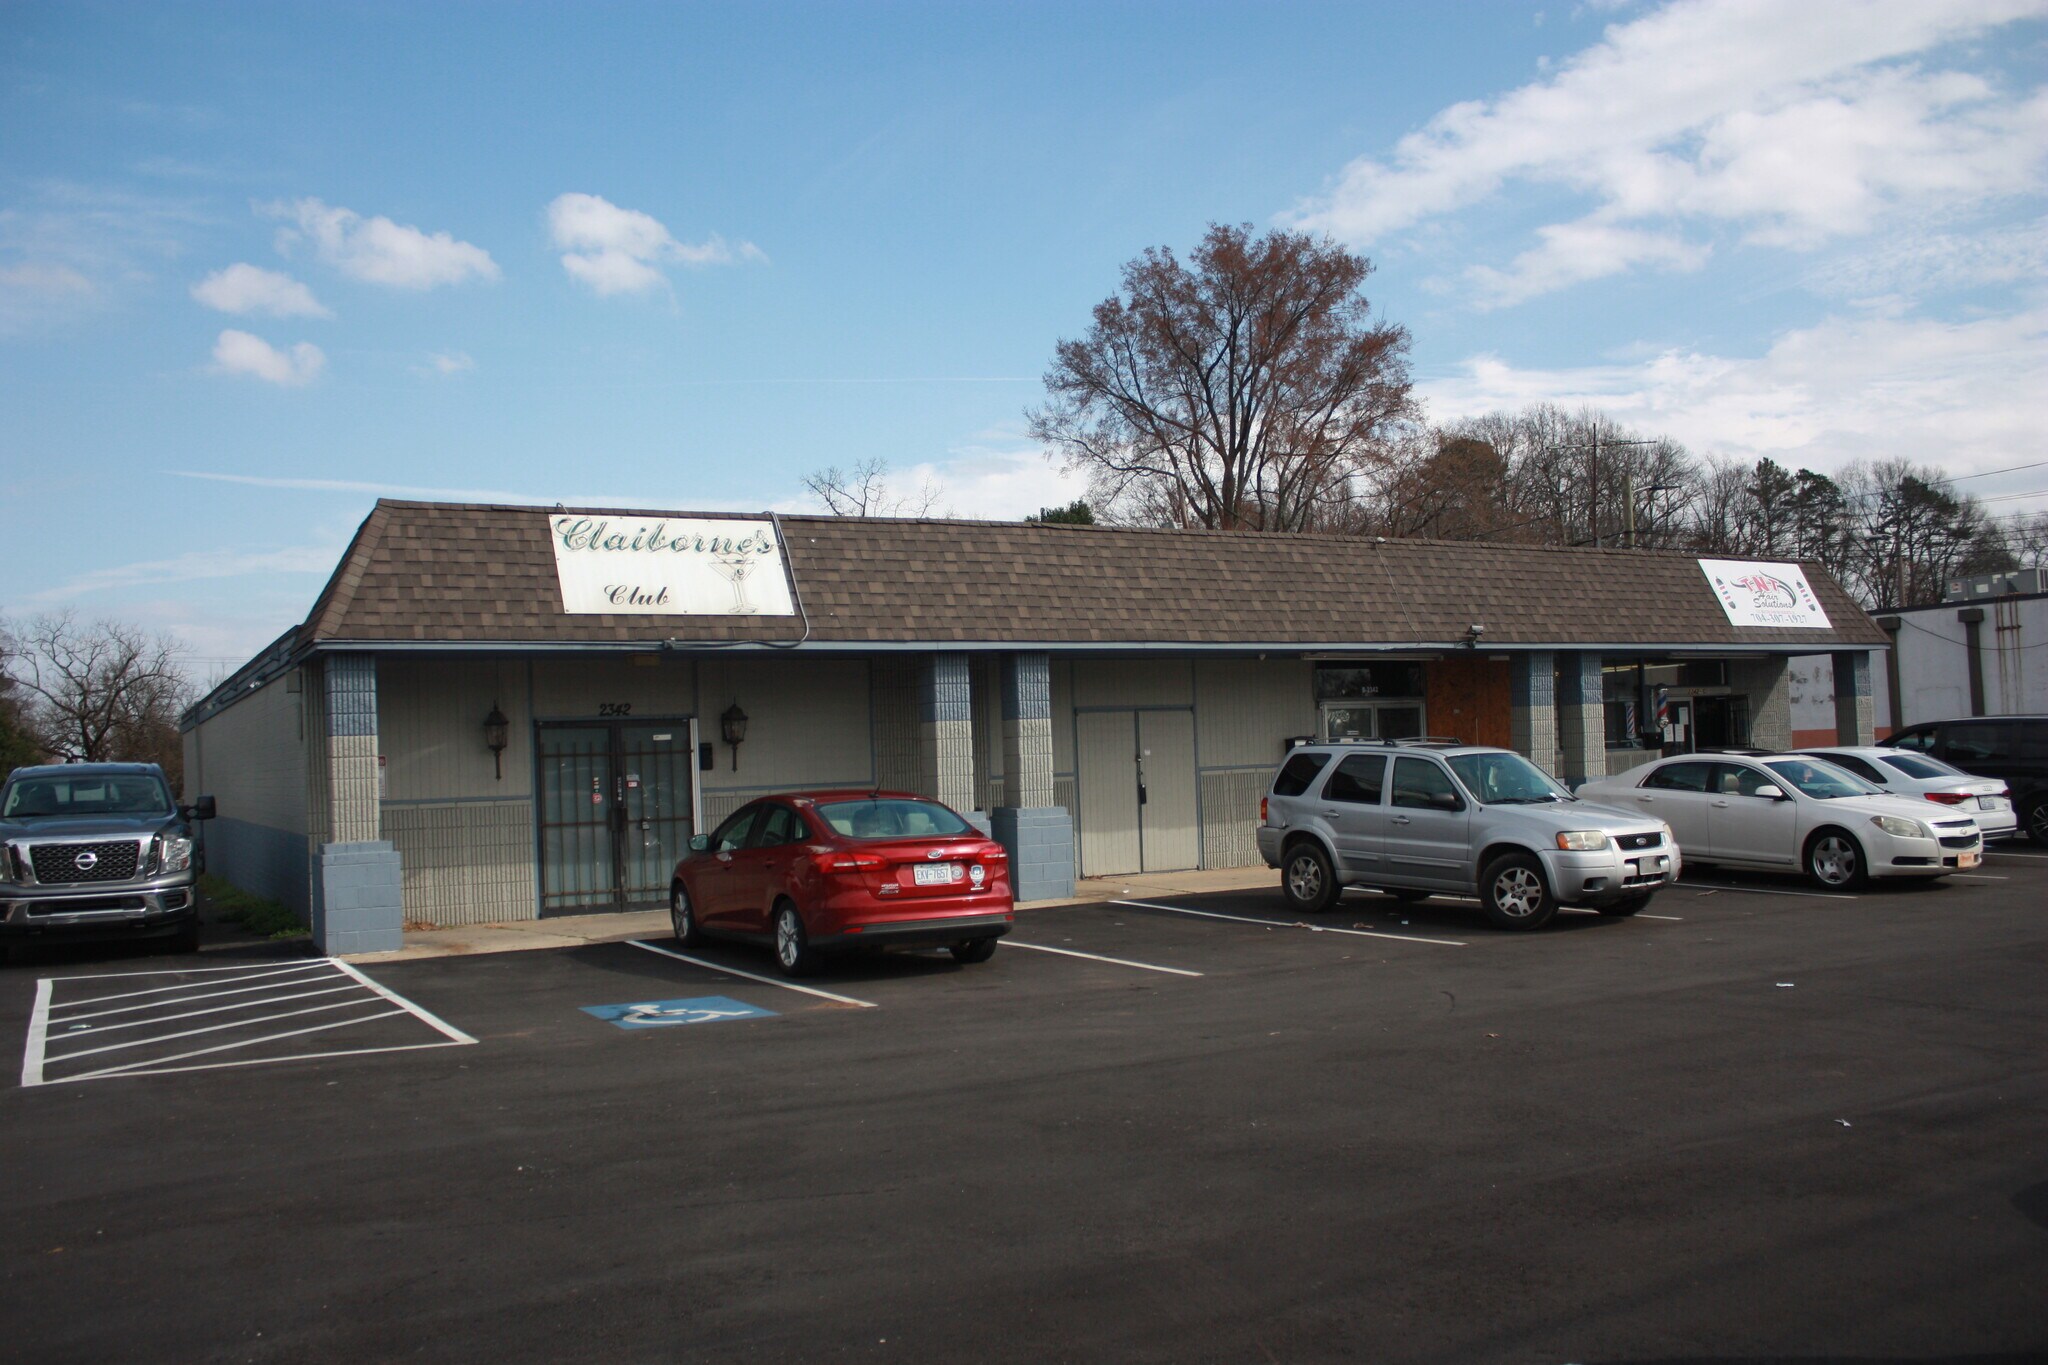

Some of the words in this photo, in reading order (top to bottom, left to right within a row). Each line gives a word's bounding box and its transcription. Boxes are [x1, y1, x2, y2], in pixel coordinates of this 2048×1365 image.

[554, 516, 775, 555] Claiborne's
[604, 584, 670, 606] Club
[1752, 598, 1793, 609] Solutions
[599, 703, 632, 716] 2342
